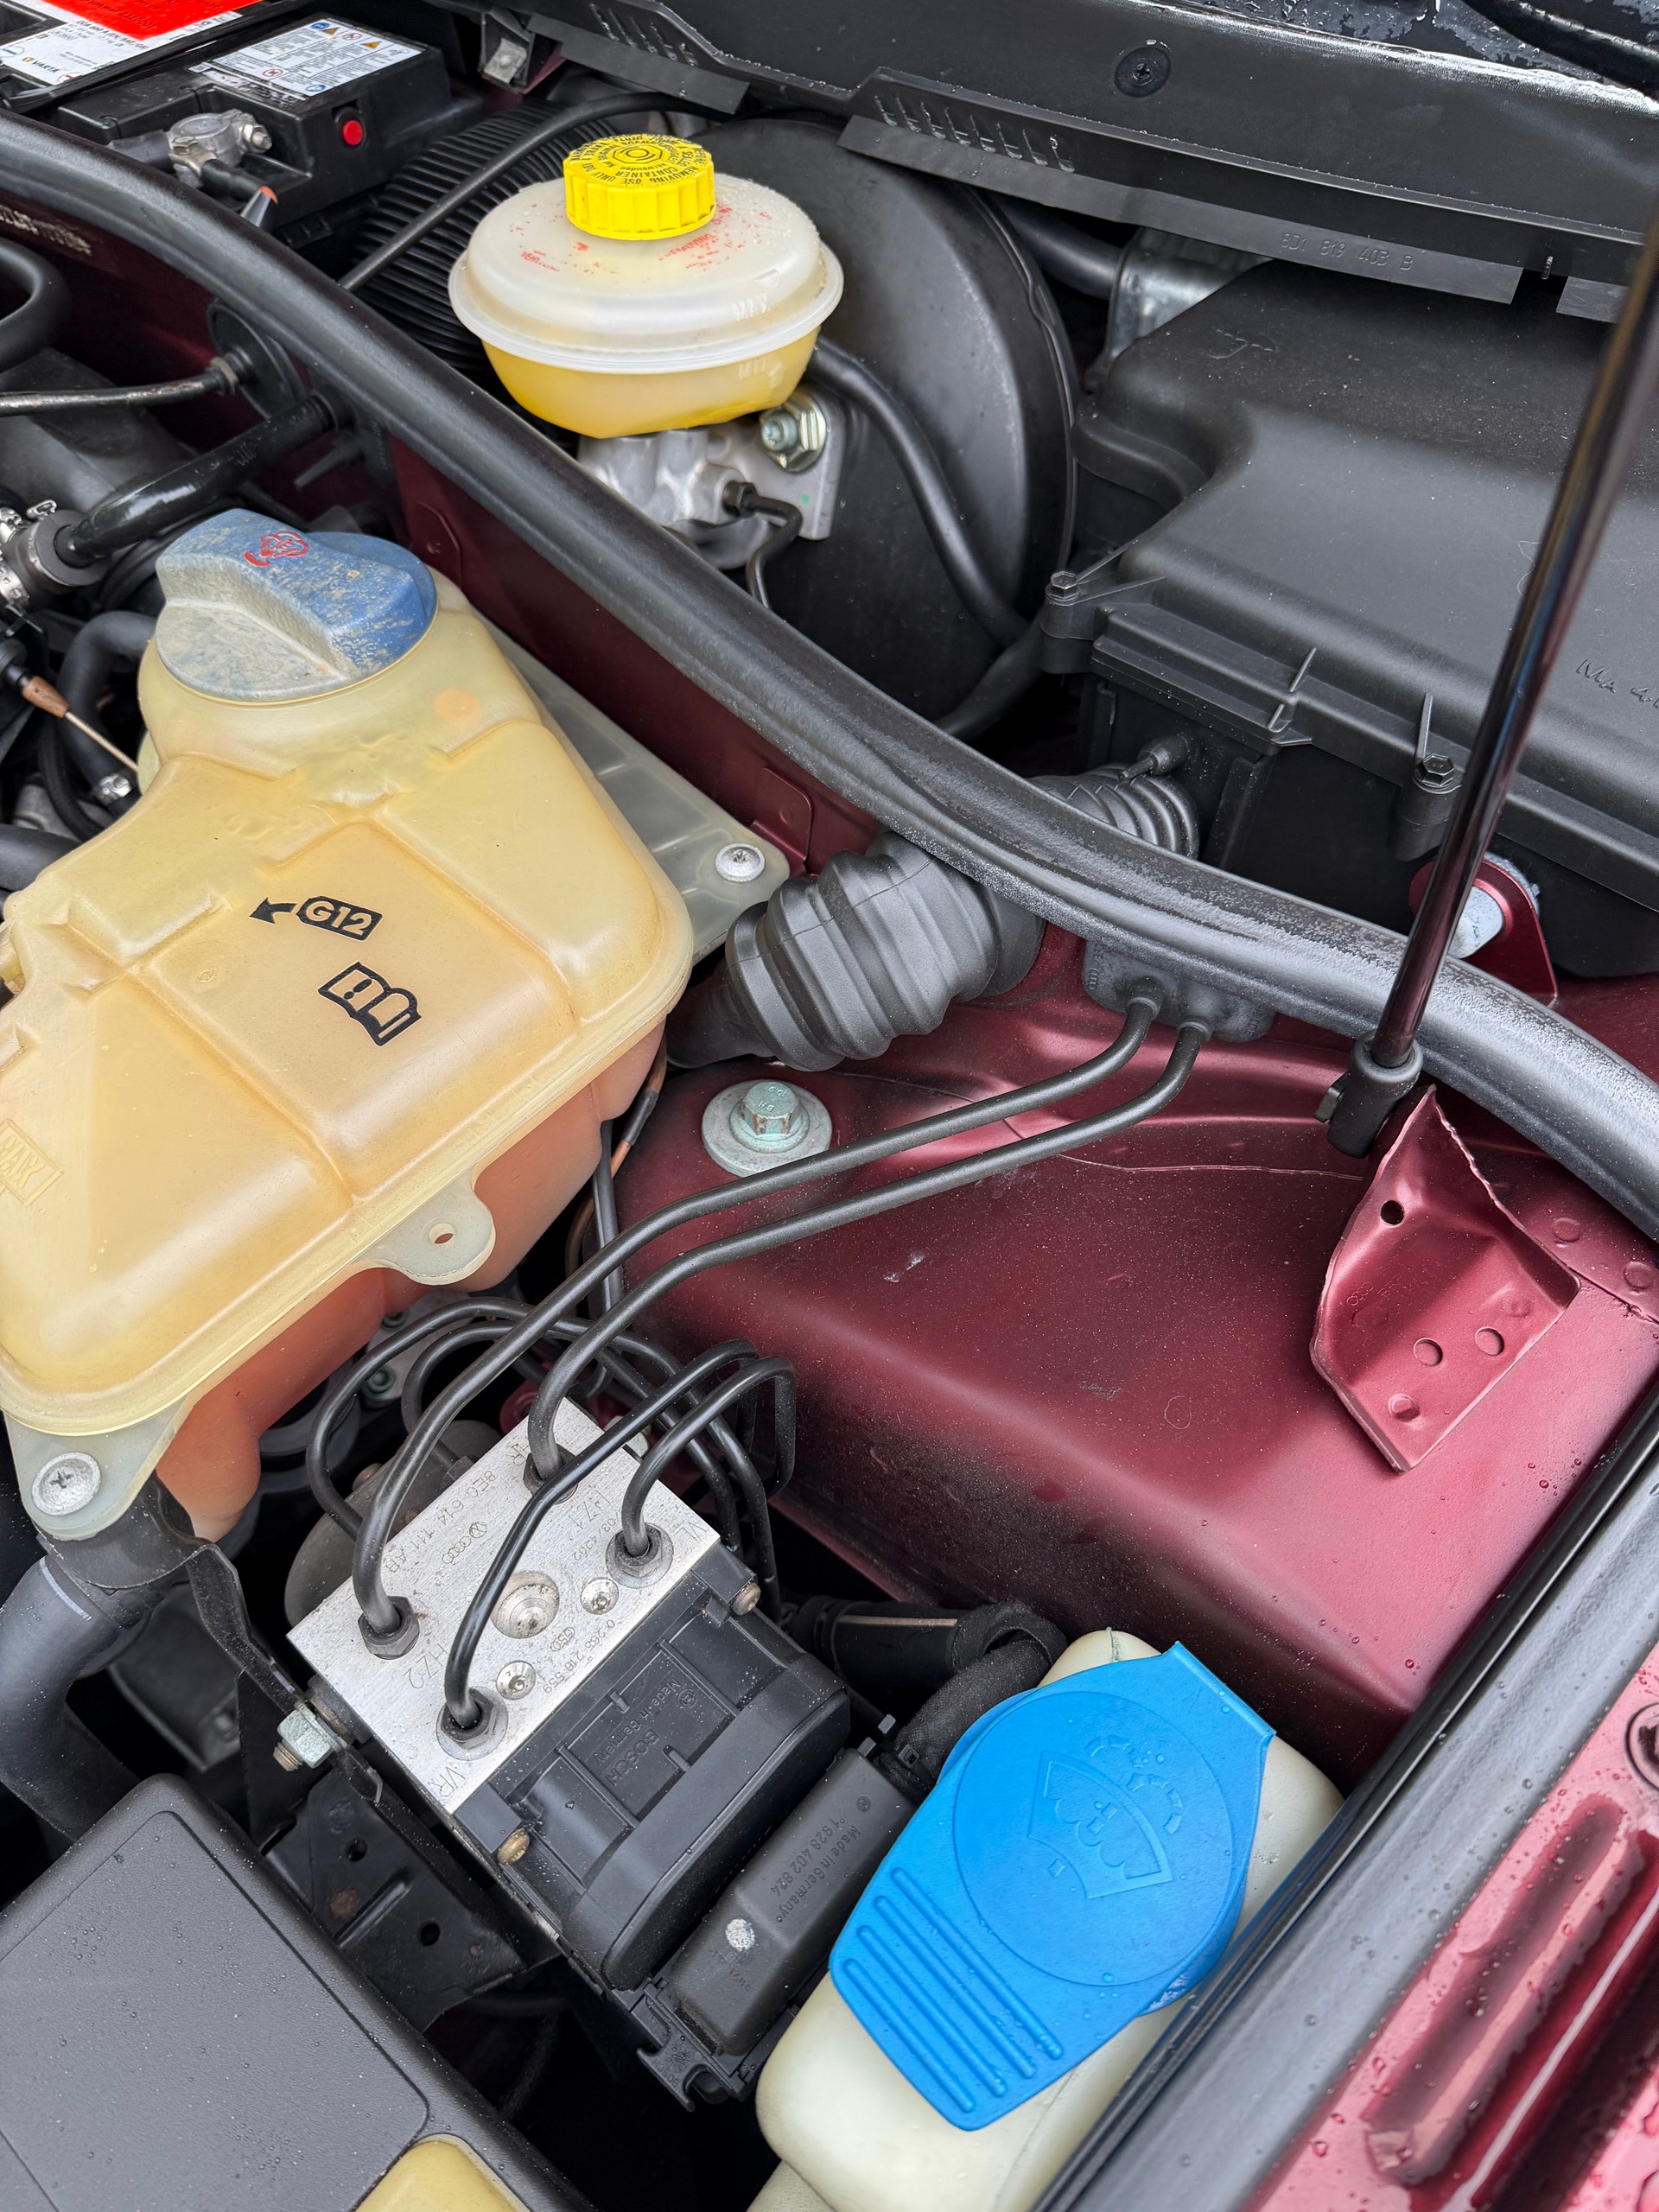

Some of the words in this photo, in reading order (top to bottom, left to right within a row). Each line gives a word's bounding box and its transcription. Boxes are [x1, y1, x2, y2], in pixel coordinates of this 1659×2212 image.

[31, 60, 60, 73] VARTA
[594, 172, 615, 183] ONLY
[615, 167, 678, 179] CONTAINER
[620, 177, 642, 186] USE
[650, 166, 699, 185] REMOVING
[1280, 232, 1308, 252] 8D1
[1320, 238, 1347, 259] 819
[1358, 247, 1390, 267] 403
[1401, 253, 1414, 272] B
[304, 899, 372, 936] G12
[467, 1470, 497, 1498] 8E0
[436, 1499, 465, 1526] 614
[410, 1527, 435, 1550] 111
[675, 1521, 708, 1542] VL
[383, 1551, 407, 1573] AB
[606, 1619, 615, 1629] 0
[584, 1627, 607, 1651] 265
[402, 1643, 448, 1690] HZ2
[543, 1671, 566, 1694] 559
[651, 1678, 681, 1706] Made
[639, 1706, 652, 1719] in
[594, 1719, 641, 1766] Germany
[605, 1728, 660, 1787] BOSCH
[429, 1765, 467, 1798] VR
[830, 1817, 840, 1828] 1
[809, 1825, 834, 1851] 928
[830, 1824, 861, 1856] Made
[789, 1848, 813, 1874] 402
[820, 1854, 836, 1868] in
[770, 1871, 794, 1897] 824
[779, 1866, 825, 1918] Germany
[652, 2058, 680, 2088] BOSCH
